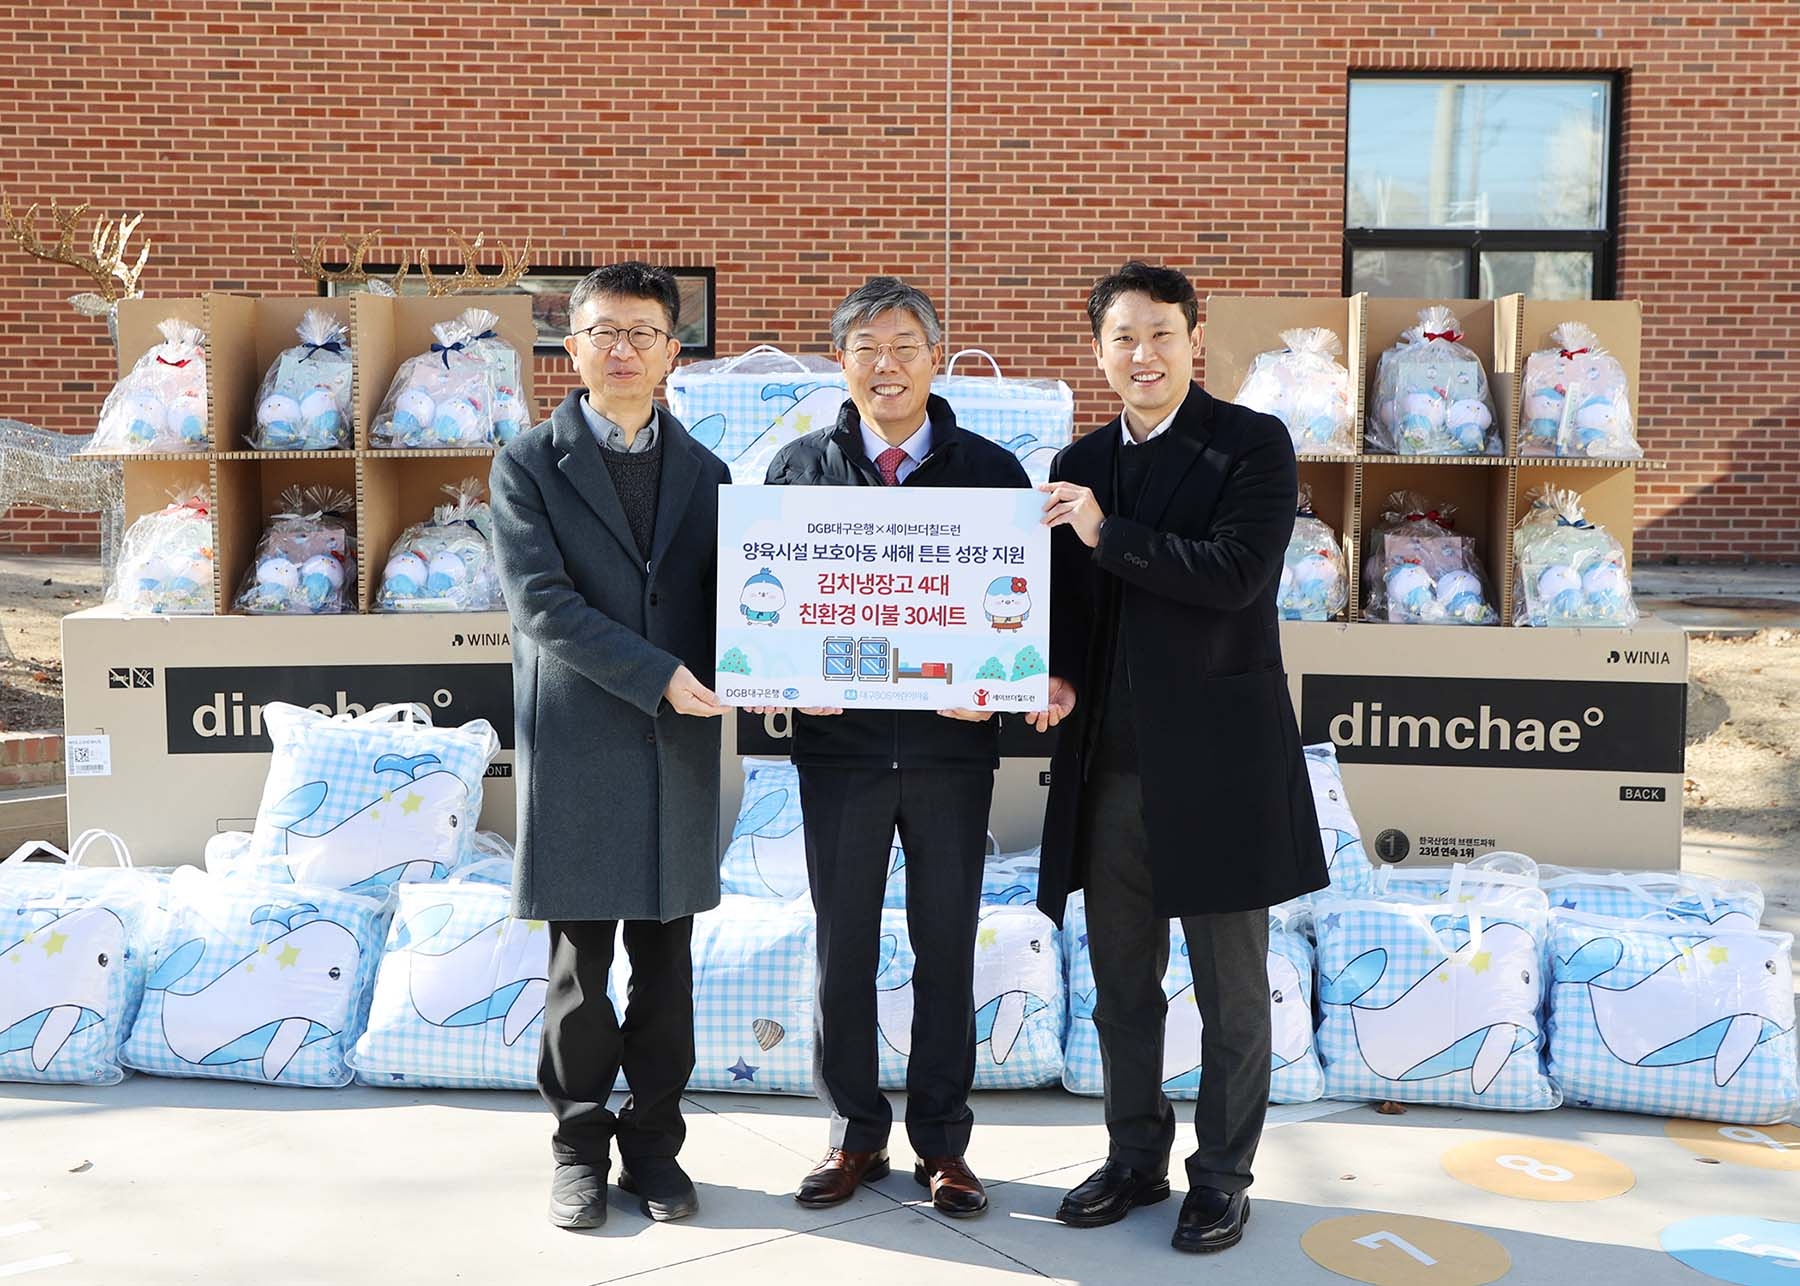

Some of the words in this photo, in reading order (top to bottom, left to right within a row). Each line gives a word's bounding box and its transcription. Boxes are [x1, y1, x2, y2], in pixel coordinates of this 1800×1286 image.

[743, 542, 808, 561] 양육시설
[812, 543, 878, 562] 보호아동
[882, 544, 914, 563] 새해
[918, 545, 951, 563] 튼튼
[955, 545, 988, 564] 성장
[992, 546, 1025, 565] 지원
[818, 573, 914, 595] 김치냉장고
[918, 574, 949, 596] 4대
[799, 603, 856, 625] 친환경
[861, 604, 900, 626] 이불
[904, 605, 967, 627] 30세트
[467, 633, 510, 646] WINIA
[1624, 651, 1670, 664] WINIA
[726, 688, 780, 699] DGB대구은행
[992, 694, 1036, 702] 세이브더칠드런
[485, 765, 510, 776] ONT
[1625, 788, 1660, 800] BACK
[1419, 847, 1440, 857] 23년
[1441, 847, 1458, 857] 연속
[1460, 848, 1475, 858] 1위
[1495, 1154, 1574, 1182] 8
[1352, 1229, 1438, 1266] 7
[1713, 1233, 1800, 1268] 5
